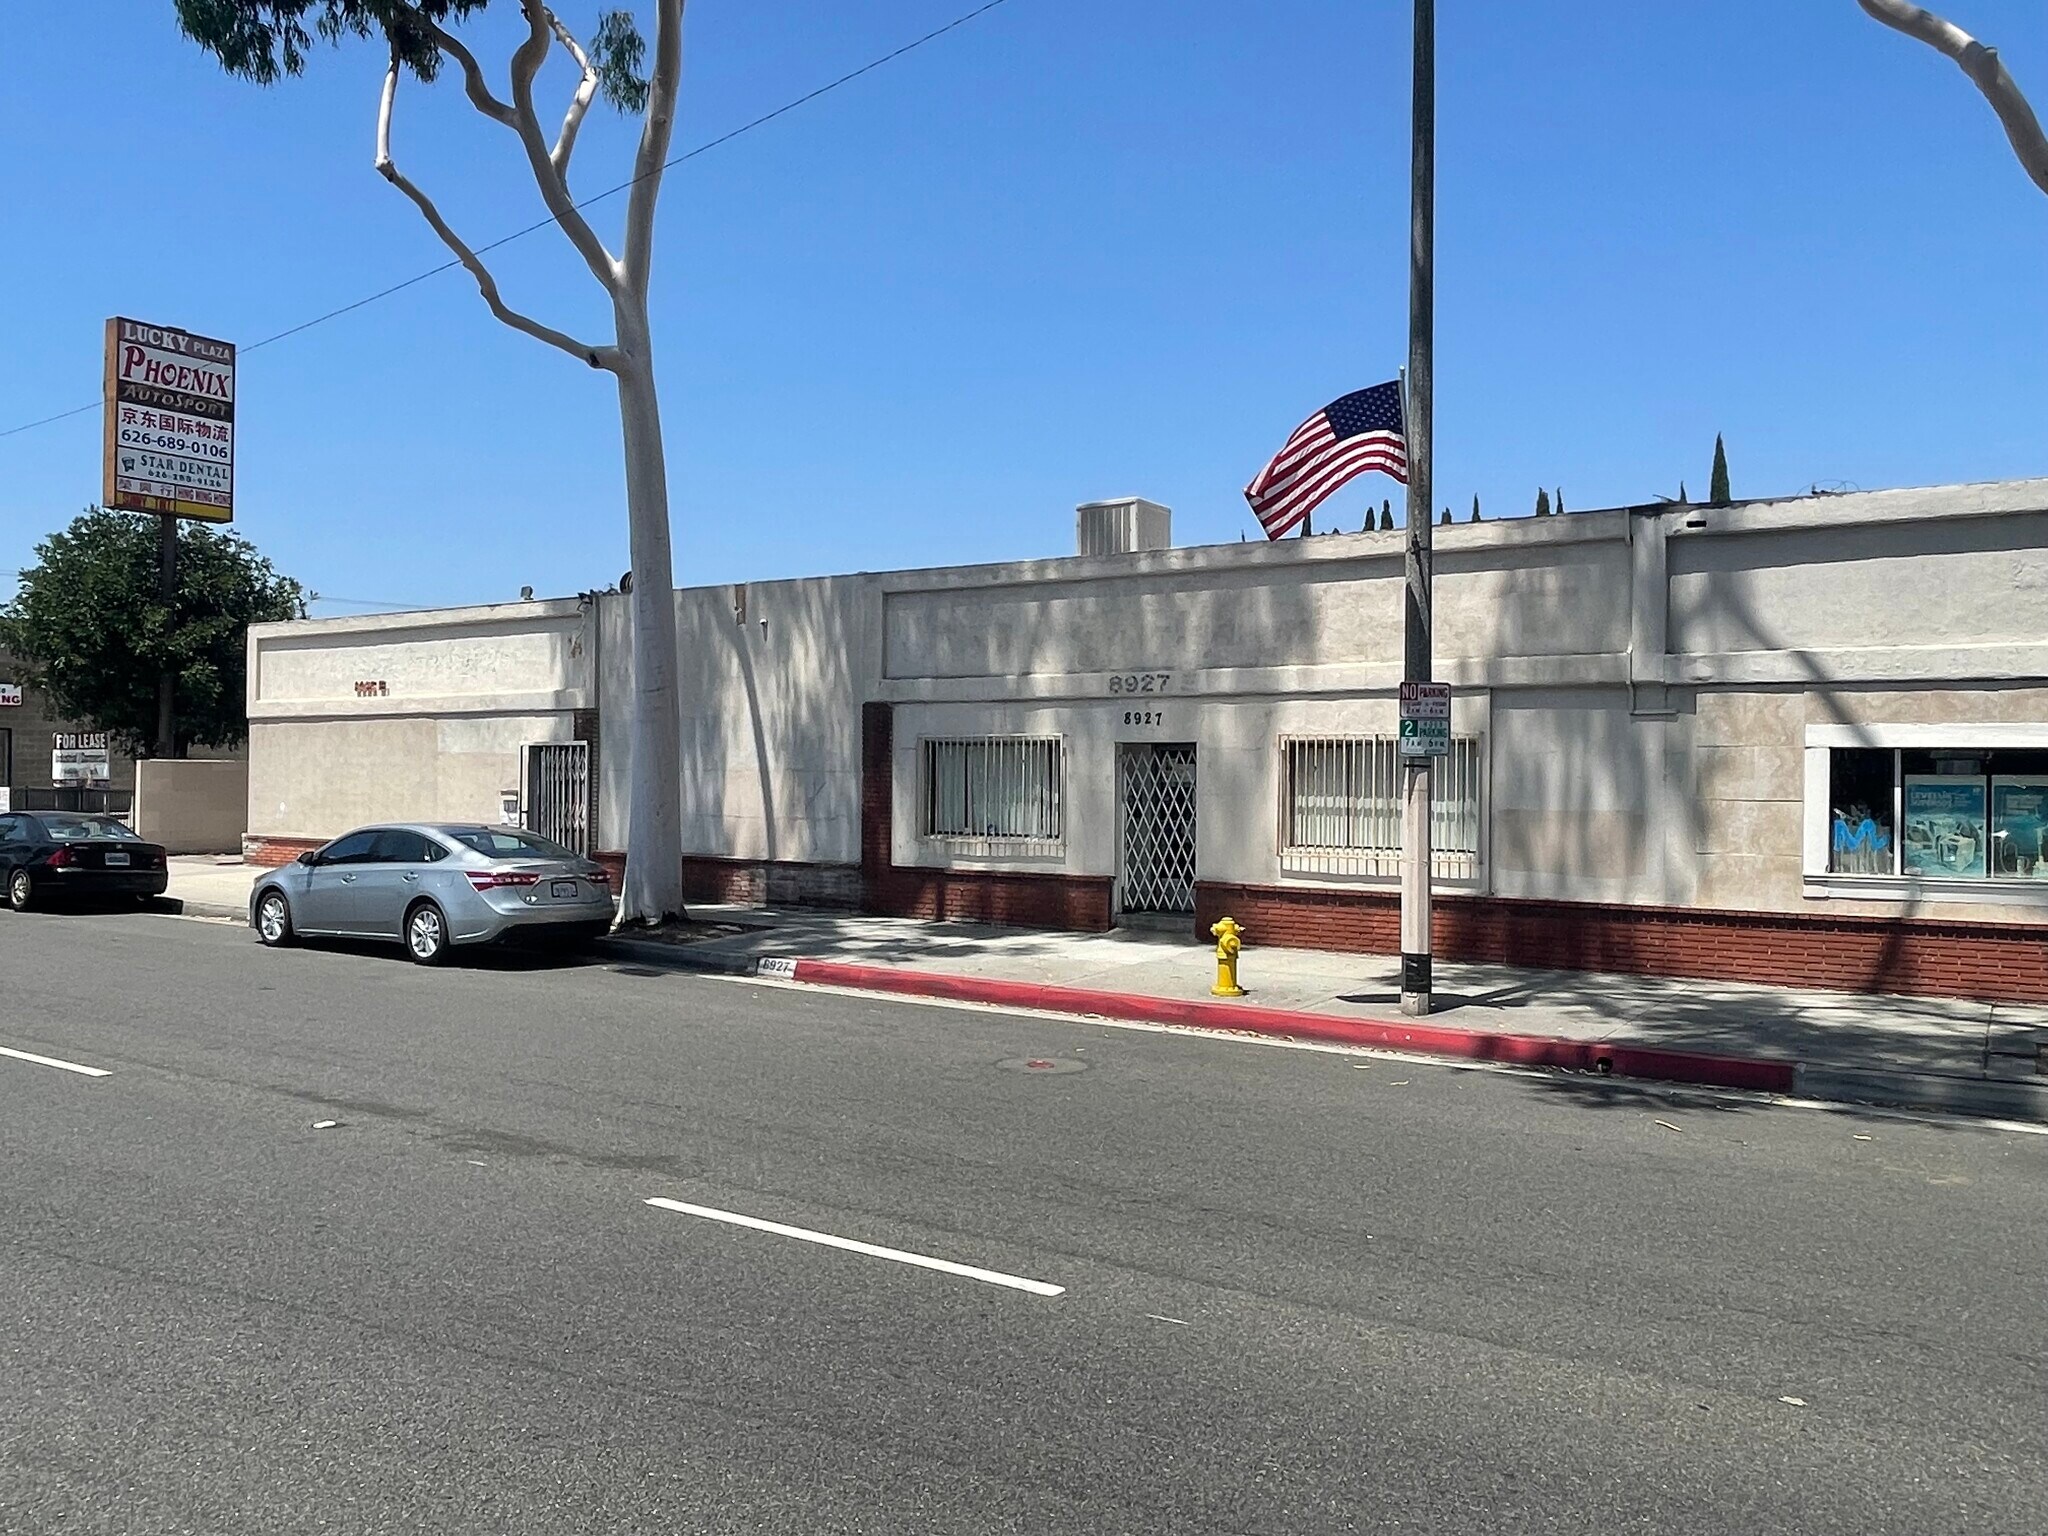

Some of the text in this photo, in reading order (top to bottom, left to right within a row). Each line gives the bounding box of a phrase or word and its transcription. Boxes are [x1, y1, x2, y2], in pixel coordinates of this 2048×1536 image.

[124, 322, 230, 360] LUCKY PLAZA
[123, 345, 230, 398] PHOENIX
[121, 407, 229, 443] 京东国际物流
[121, 429, 228, 459] 626-689-0106
[140, 454, 229, 480] STAR DENTAL
[1109, 673, 1171, 694] 8927
[1402, 684, 1449, 699] NO PARKING
[1124, 711, 1163, 726] 8927
[1404, 720, 1414, 736] 2
[1420, 728, 1448, 738] PARKING
[56, 733, 106, 749] FOR LEASE
[762, 959, 791, 972] 8927
